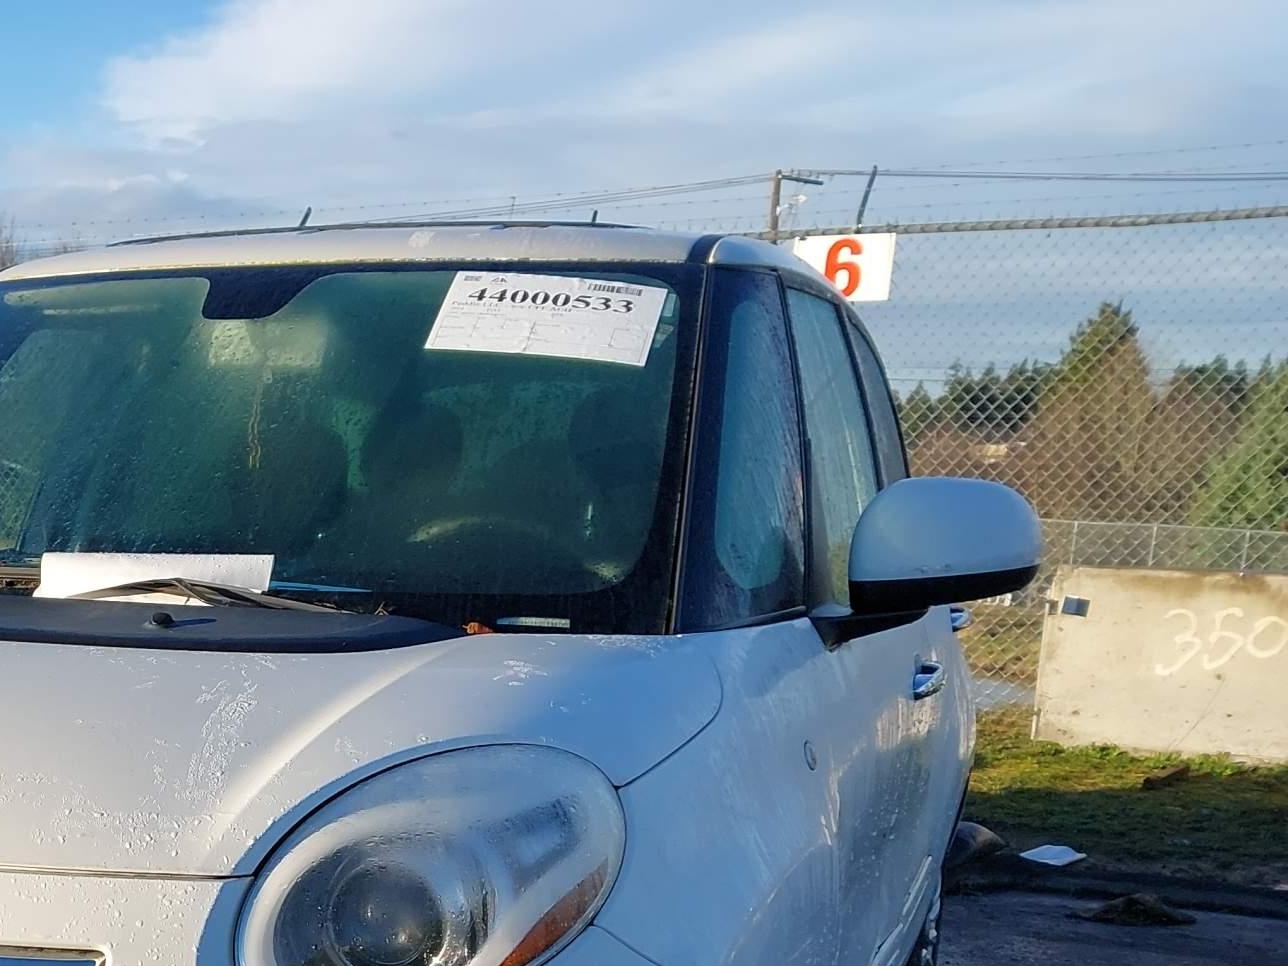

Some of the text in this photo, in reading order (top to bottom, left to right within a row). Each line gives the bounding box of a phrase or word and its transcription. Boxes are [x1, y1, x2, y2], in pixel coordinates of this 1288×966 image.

[824, 238, 863, 298] 6
[468, 286, 635, 314] 44000533
[1155, 607, 1288, 676] 350
